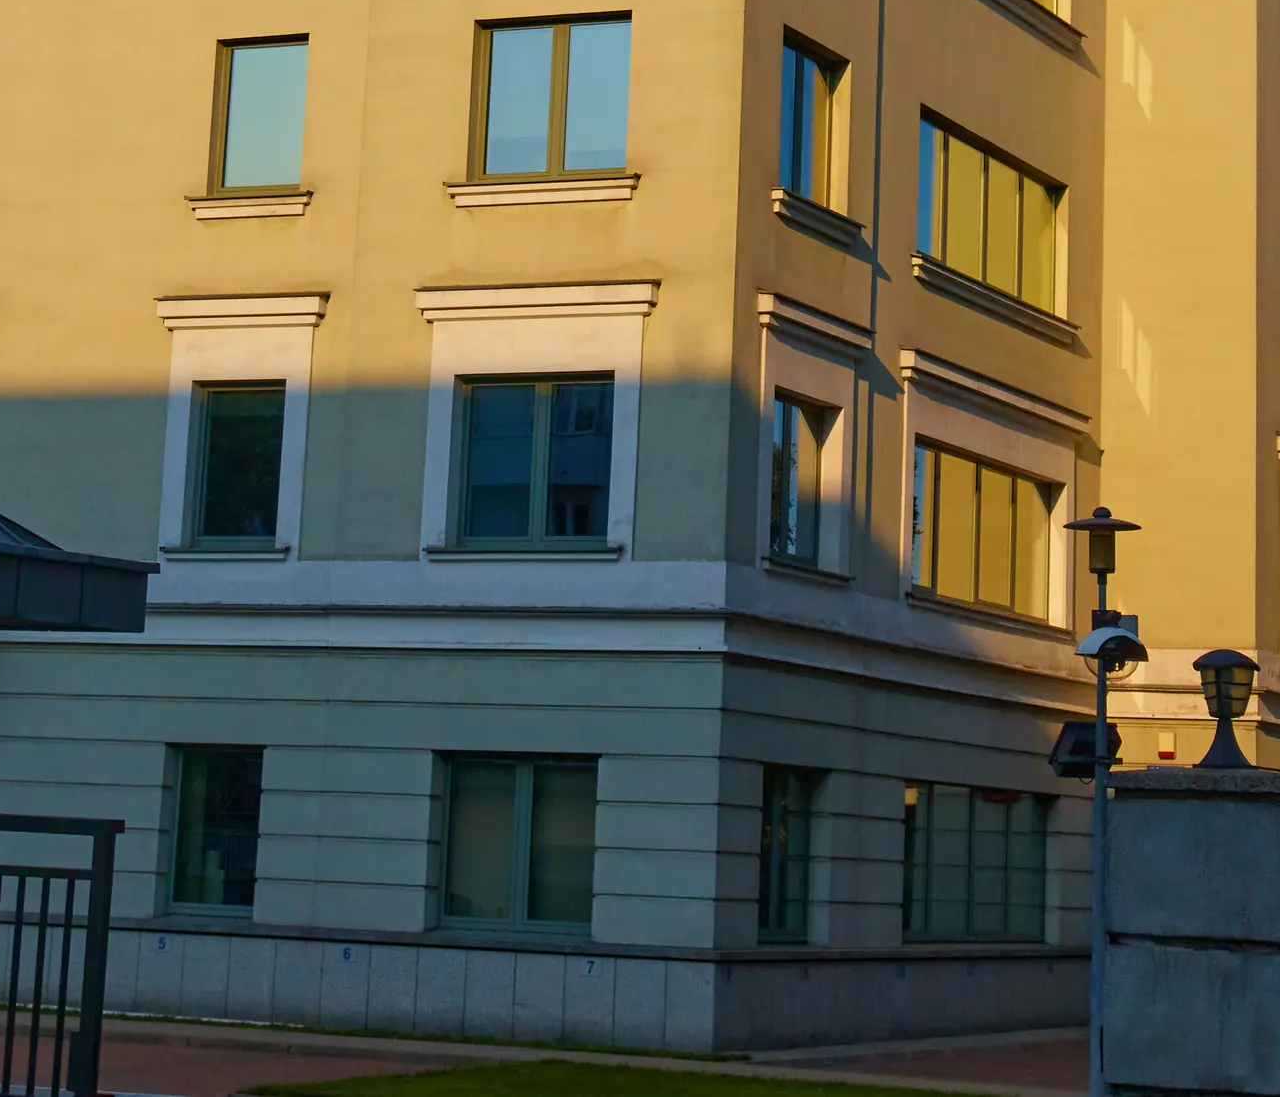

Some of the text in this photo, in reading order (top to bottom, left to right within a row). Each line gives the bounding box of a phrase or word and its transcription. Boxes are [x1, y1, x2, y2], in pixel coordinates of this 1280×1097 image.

[158, 937, 166, 950] 5
[343, 947, 351, 960] 6
[587, 961, 595, 974] 7
